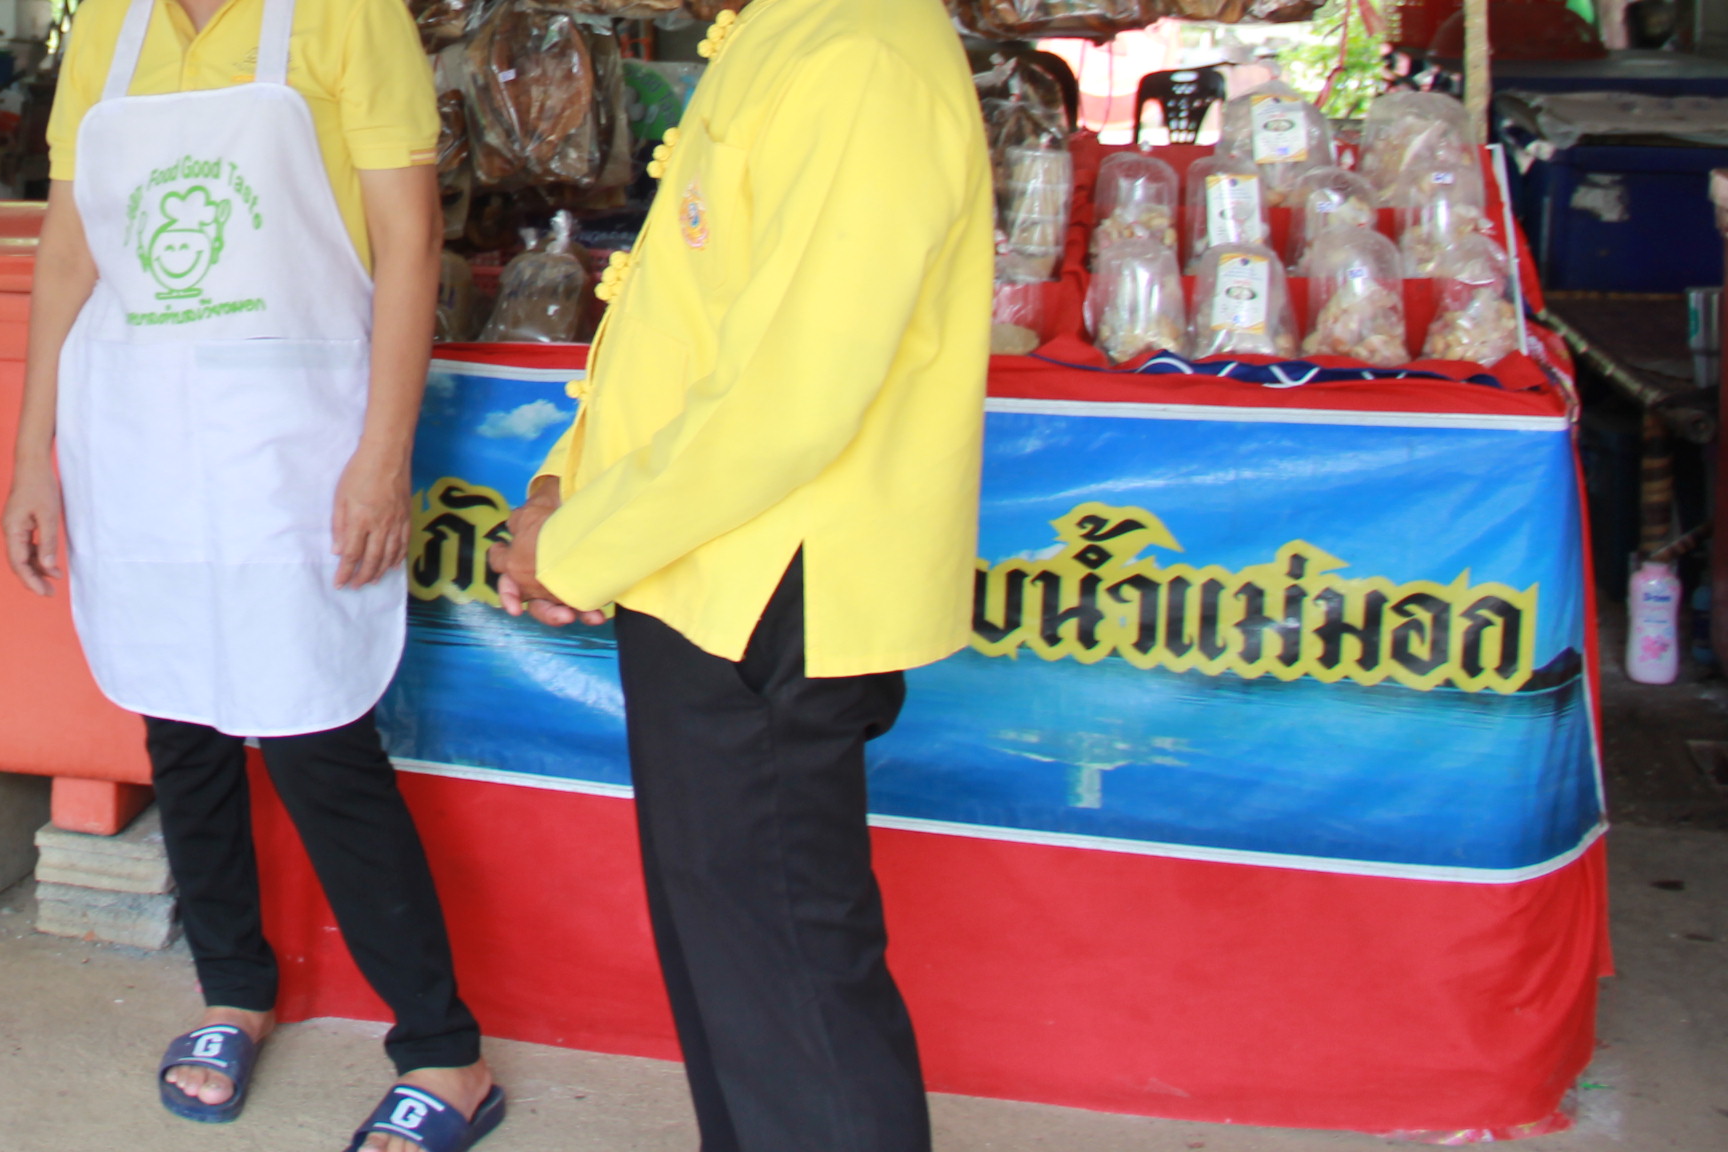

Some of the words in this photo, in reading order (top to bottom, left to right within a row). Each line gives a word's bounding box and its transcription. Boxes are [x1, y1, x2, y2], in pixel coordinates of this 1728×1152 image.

[182, 154, 222, 179] Good
[193, 1032, 223, 1058] G
[390, 1097, 428, 1130] G
